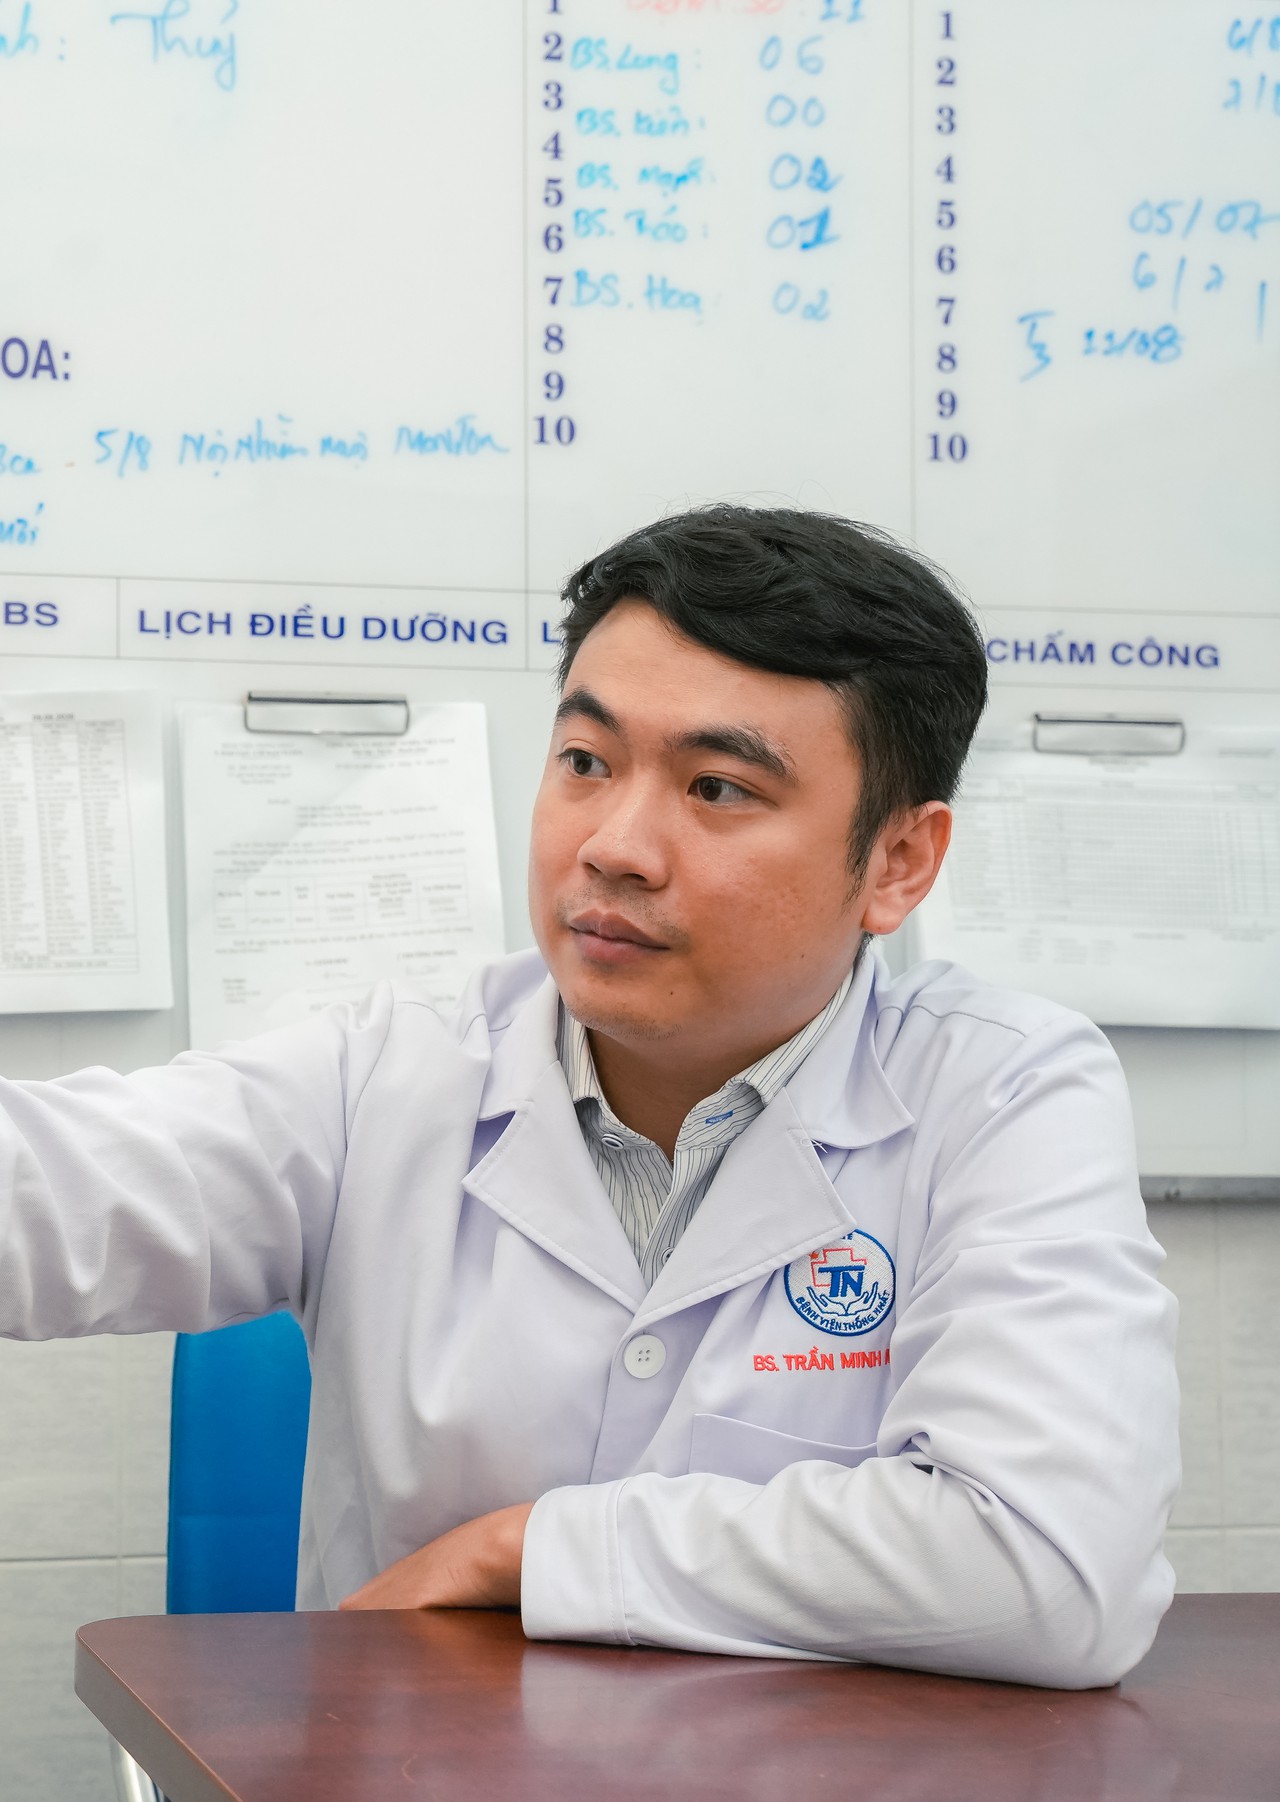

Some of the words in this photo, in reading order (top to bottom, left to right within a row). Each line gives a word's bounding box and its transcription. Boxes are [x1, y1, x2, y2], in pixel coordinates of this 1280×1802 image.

[939, 9, 957, 41] 1
[543, 32, 564, 63] 2
[936, 56, 957, 87] 2
[543, 81, 564, 112] 3
[936, 106, 957, 136] 3
[542, 132, 564, 161] 4
[935, 155, 956, 184] 4
[543, 178, 564, 207] 5
[936, 200, 957, 230] 5
[543, 223, 564, 254] 6
[935, 245, 957, 275] 6
[543, 277, 564, 306] 7
[936, 297, 957, 327] 7
[544, 323, 565, 354] 8
[936, 343, 957, 374] 8
[543, 371, 564, 401] 9
[937, 389, 958, 420] 9
[533, 416, 576, 446] 10
[928, 433, 969, 463] 10
[4, 602, 60, 627] BS
[138, 608, 232, 639] LỊCH
[250, 604, 346, 639] ĐIỀU
[363, 612, 508, 644] DƯỠNG
[986, 630, 1095, 665] CHẤM
[1111, 637, 1220, 668] CÔNG
[818, 1265, 865, 1297] TN
[753, 1354, 780, 1372] BS.
[782, 1346, 835, 1372] TRẦN
[840, 1350, 882, 1370] MINH
